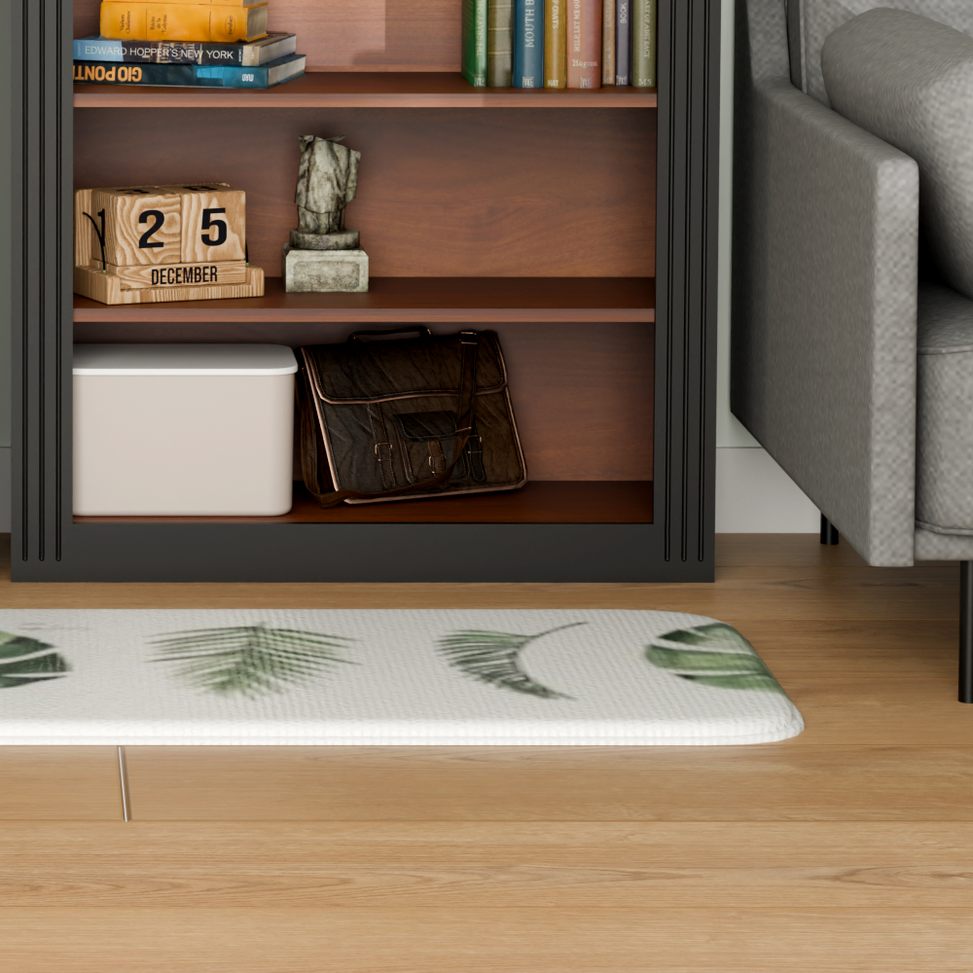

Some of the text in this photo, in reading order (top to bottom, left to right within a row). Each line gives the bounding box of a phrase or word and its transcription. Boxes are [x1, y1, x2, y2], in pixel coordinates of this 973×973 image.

[525, 9, 535, 48] MOUTH
[84, 45, 128, 56] EDWARD
[129, 47, 179, 58] HOPPER'S
[180, 48, 204, 59] NEW
[205, 50, 234, 60] YORK
[117, 66, 143, 83] GIO
[138, 207, 228, 249] 2 5
[151, 265, 218, 286] DECEMBER
